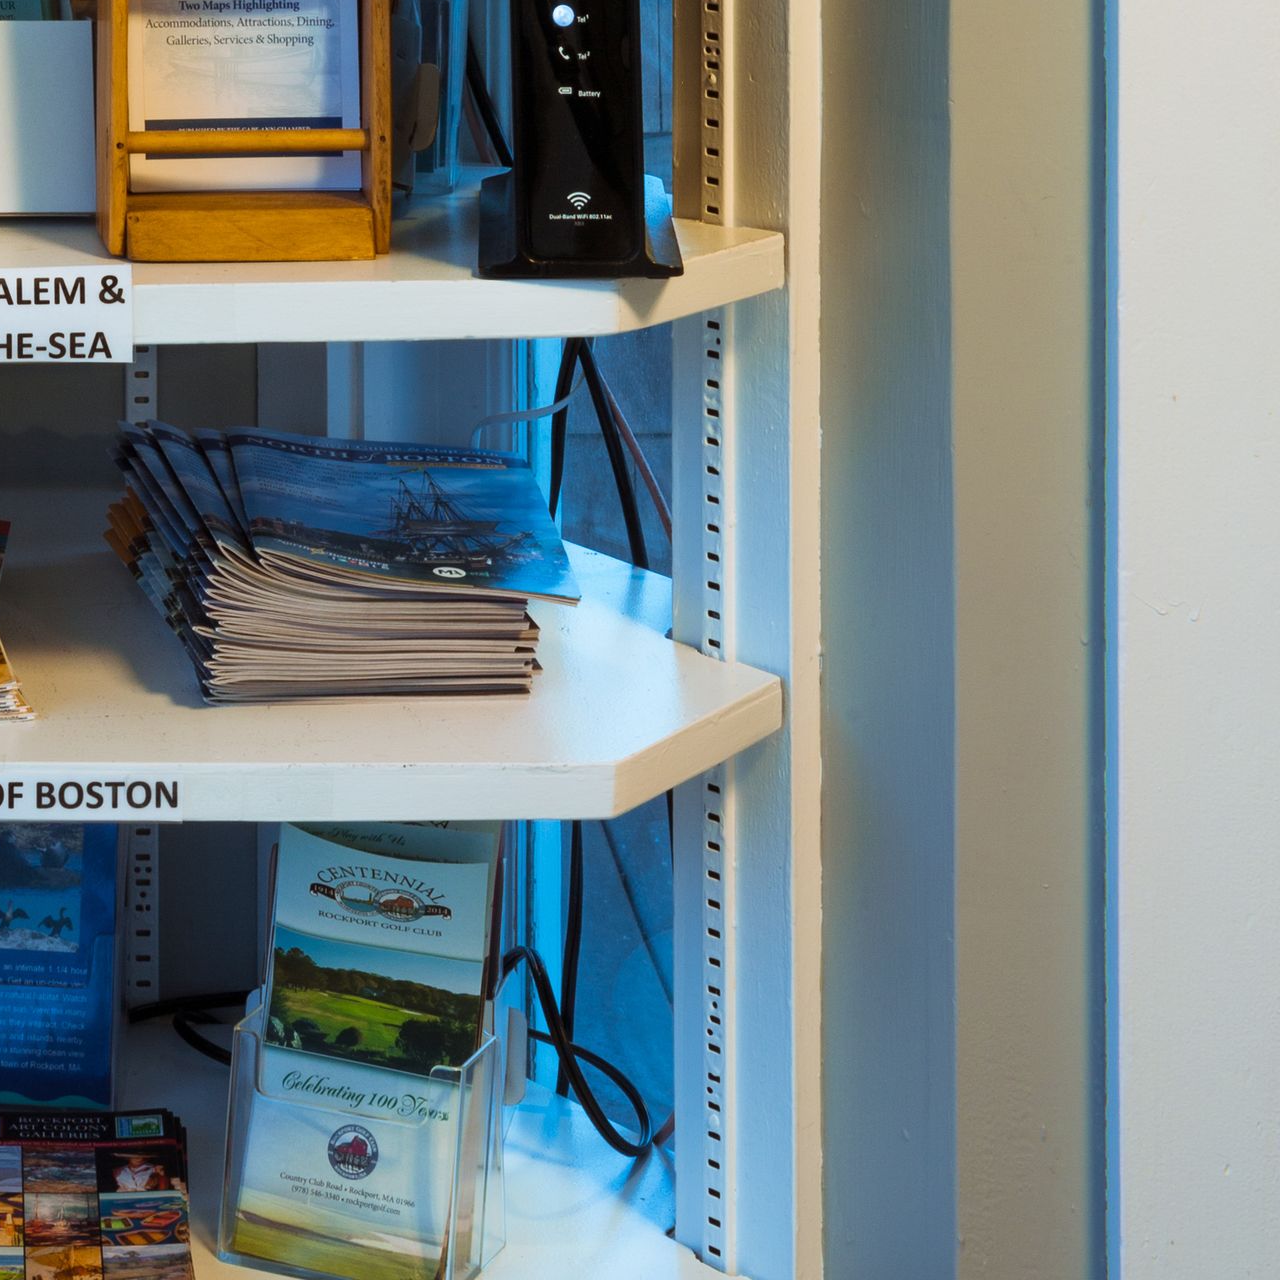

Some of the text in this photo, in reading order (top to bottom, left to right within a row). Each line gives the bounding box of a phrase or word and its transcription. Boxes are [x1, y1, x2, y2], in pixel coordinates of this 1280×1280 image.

[179, 0, 200, 12] Two
[203, 0, 228, 14] Maps
[99, 275, 125, 304] &
[36, 780, 178, 809] BOSTON
[316, 866, 445, 904] CENTENNIAL
[318, 910, 442, 938] ROCKPORT GOLF CLUB
[281, 1071, 398, 1110] Celebrating 100
